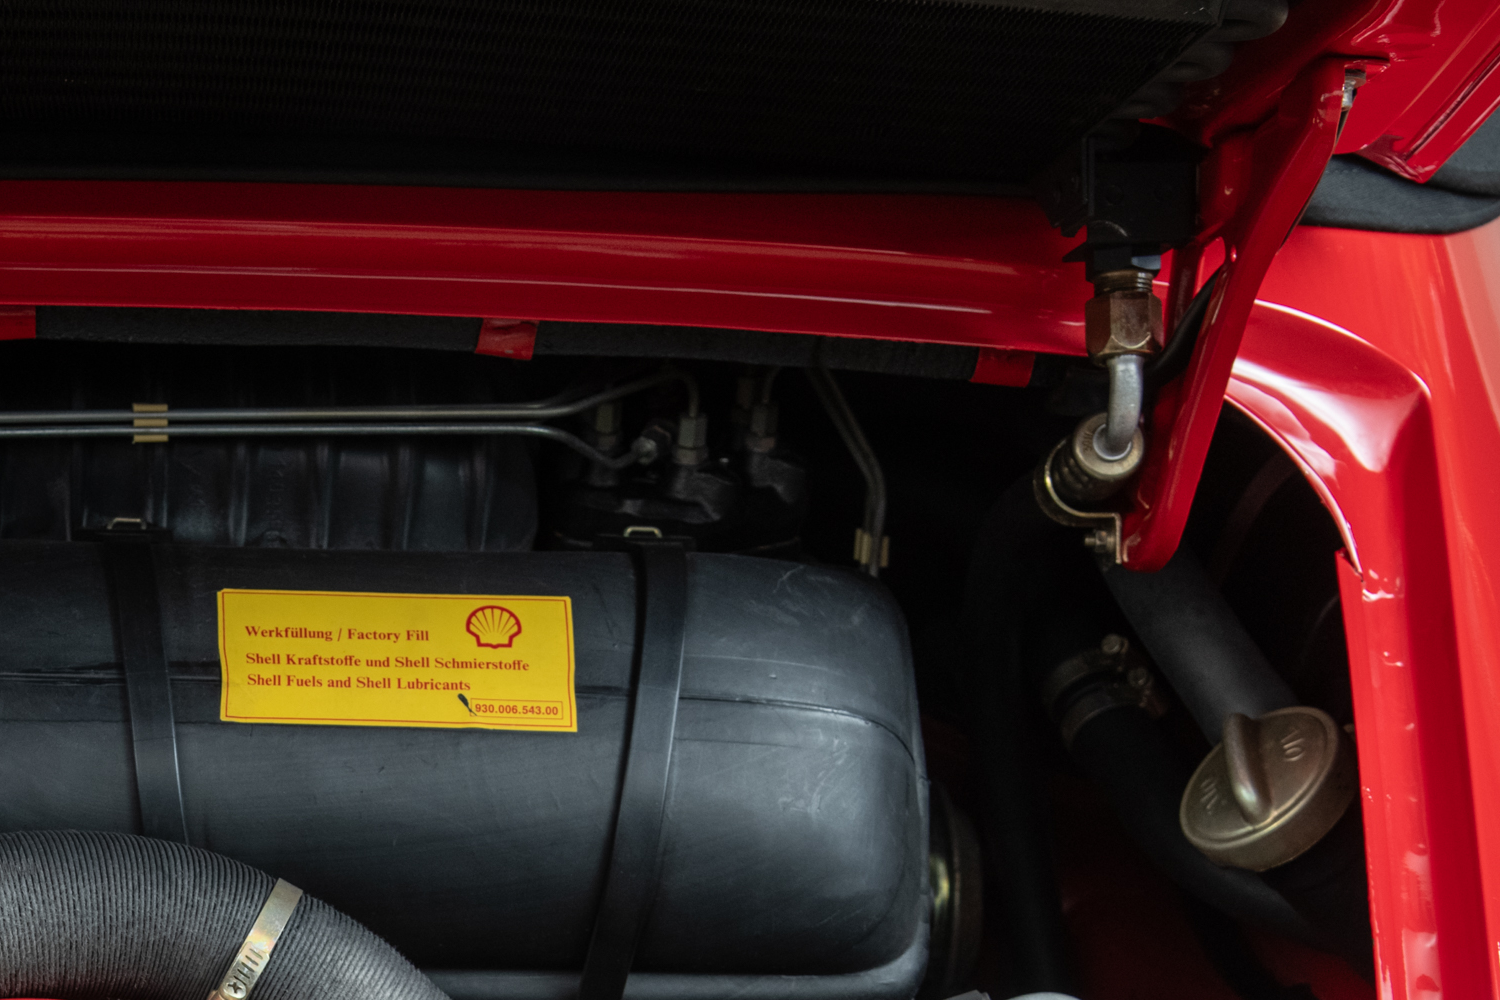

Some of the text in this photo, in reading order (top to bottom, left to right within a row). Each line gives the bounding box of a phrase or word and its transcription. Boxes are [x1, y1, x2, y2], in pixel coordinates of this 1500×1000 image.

[245, 625, 333, 642] Werkfüllung
[347, 628, 401, 643] Factory
[406, 629, 429, 642] Fill
[246, 653, 530, 671] Shell Kraftstoffe und Shell Schmierstoffe
[247, 674, 470, 691] Shell Fuels and Shell Lubricants
[474, 704, 558, 716] 930.006.543.00
